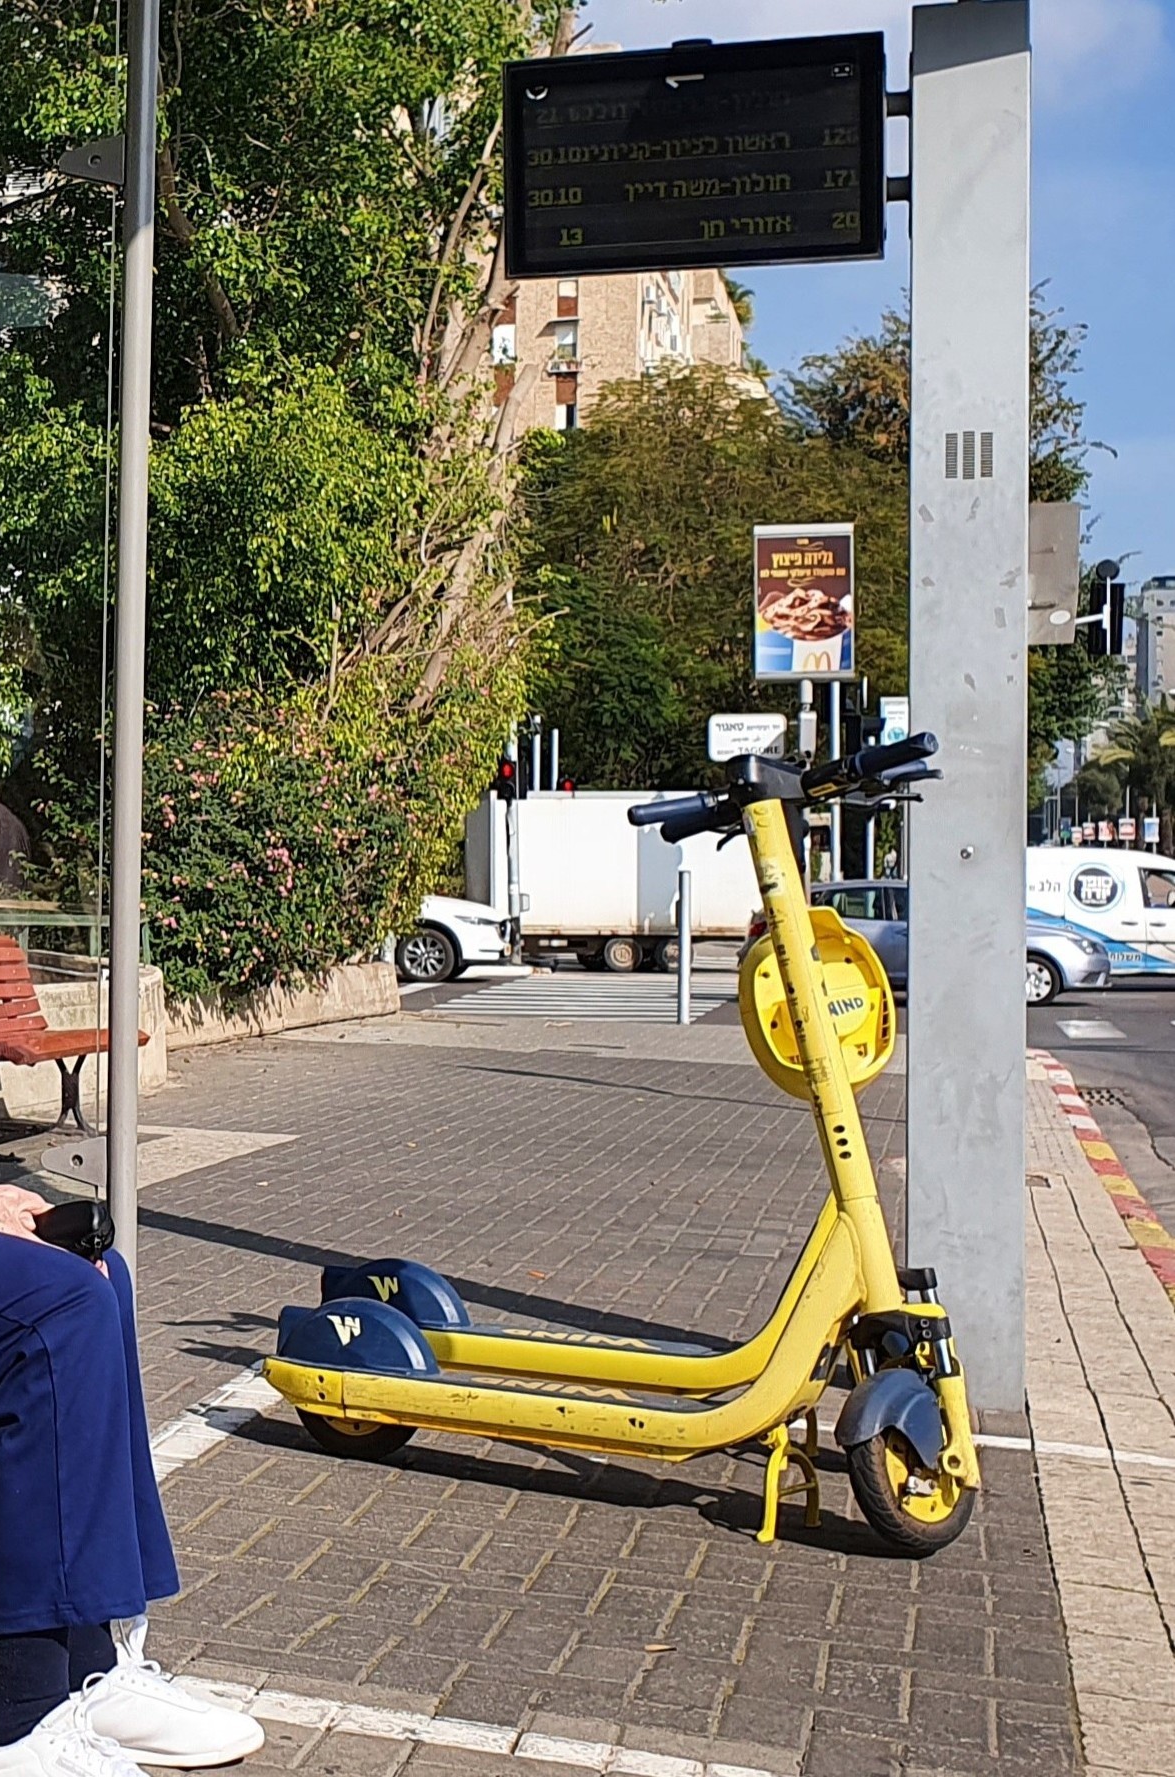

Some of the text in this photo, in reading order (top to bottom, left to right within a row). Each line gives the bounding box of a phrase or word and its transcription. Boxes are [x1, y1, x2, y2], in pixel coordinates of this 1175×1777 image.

[725, 132, 792, 153] ראשון
[673, 172, 792, 200] חולון-משה
[823, 168, 859, 188] 171
[624, 181, 668, 203] דיין
[559, 227, 583, 246] 13
[699, 218, 726, 240] חן
[732, 214, 793, 237] אזורי
[771, 550, 834, 569] גלידה פיצוץ
[715, 722, 745, 732] טאגור
[737, 745, 780, 755] TAGORE
[367, 1275, 399, 1302] W
[326, 1314, 361, 1347] W
[502, 1327, 662, 1351] WIND
[470, 1376, 645, 1404] WIND
